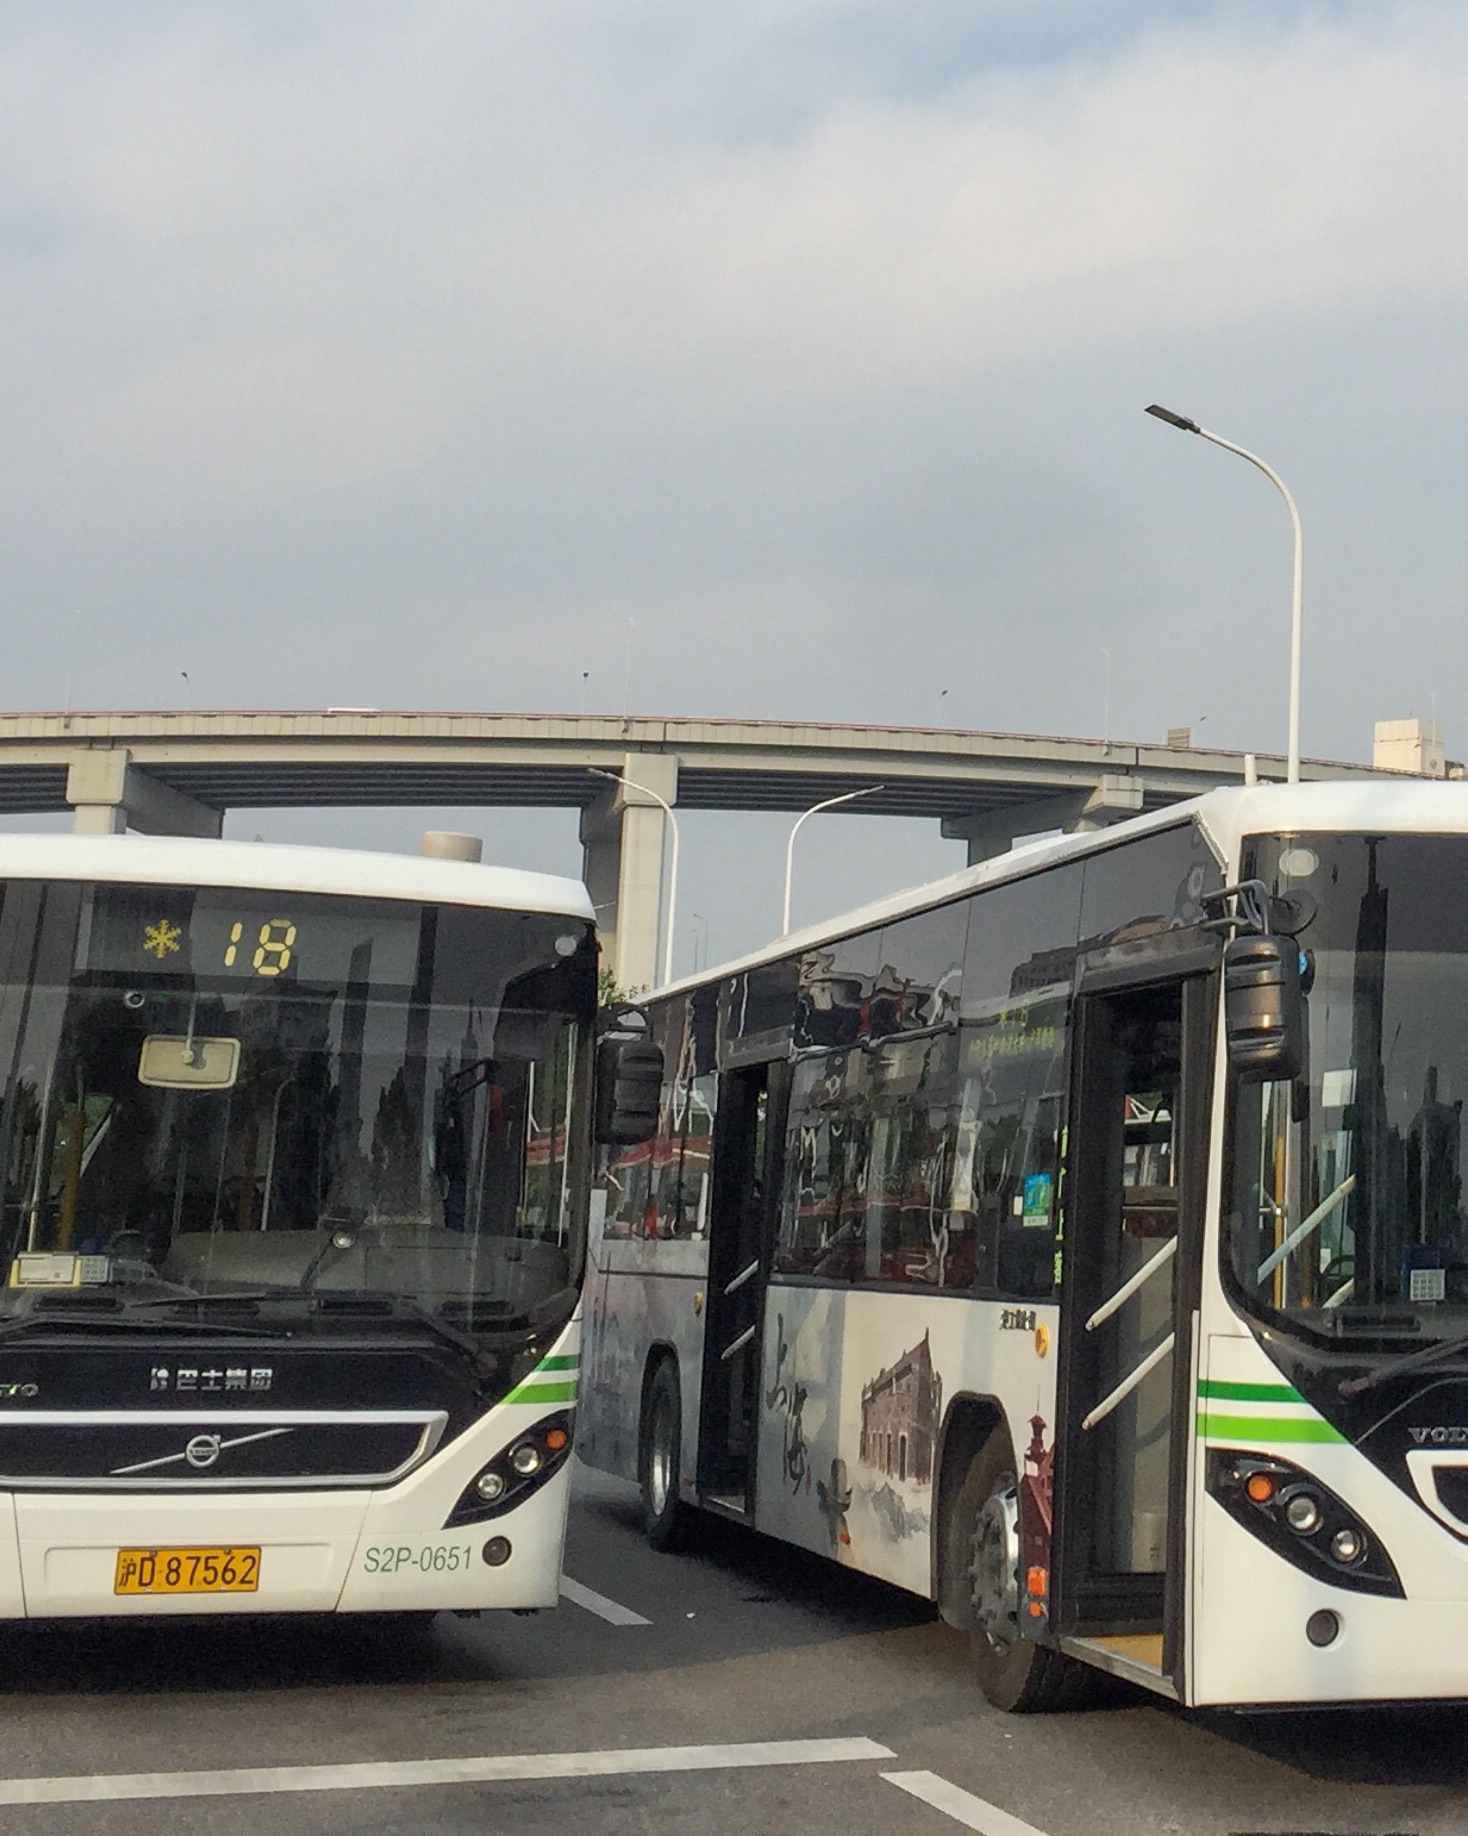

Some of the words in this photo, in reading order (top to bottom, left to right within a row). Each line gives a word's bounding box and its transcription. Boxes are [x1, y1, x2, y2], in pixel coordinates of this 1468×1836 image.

[223, 918, 298, 976] 18
[176, 1368, 273, 1392] 巴士集团
[364, 1545, 472, 1573] S2P-0651
